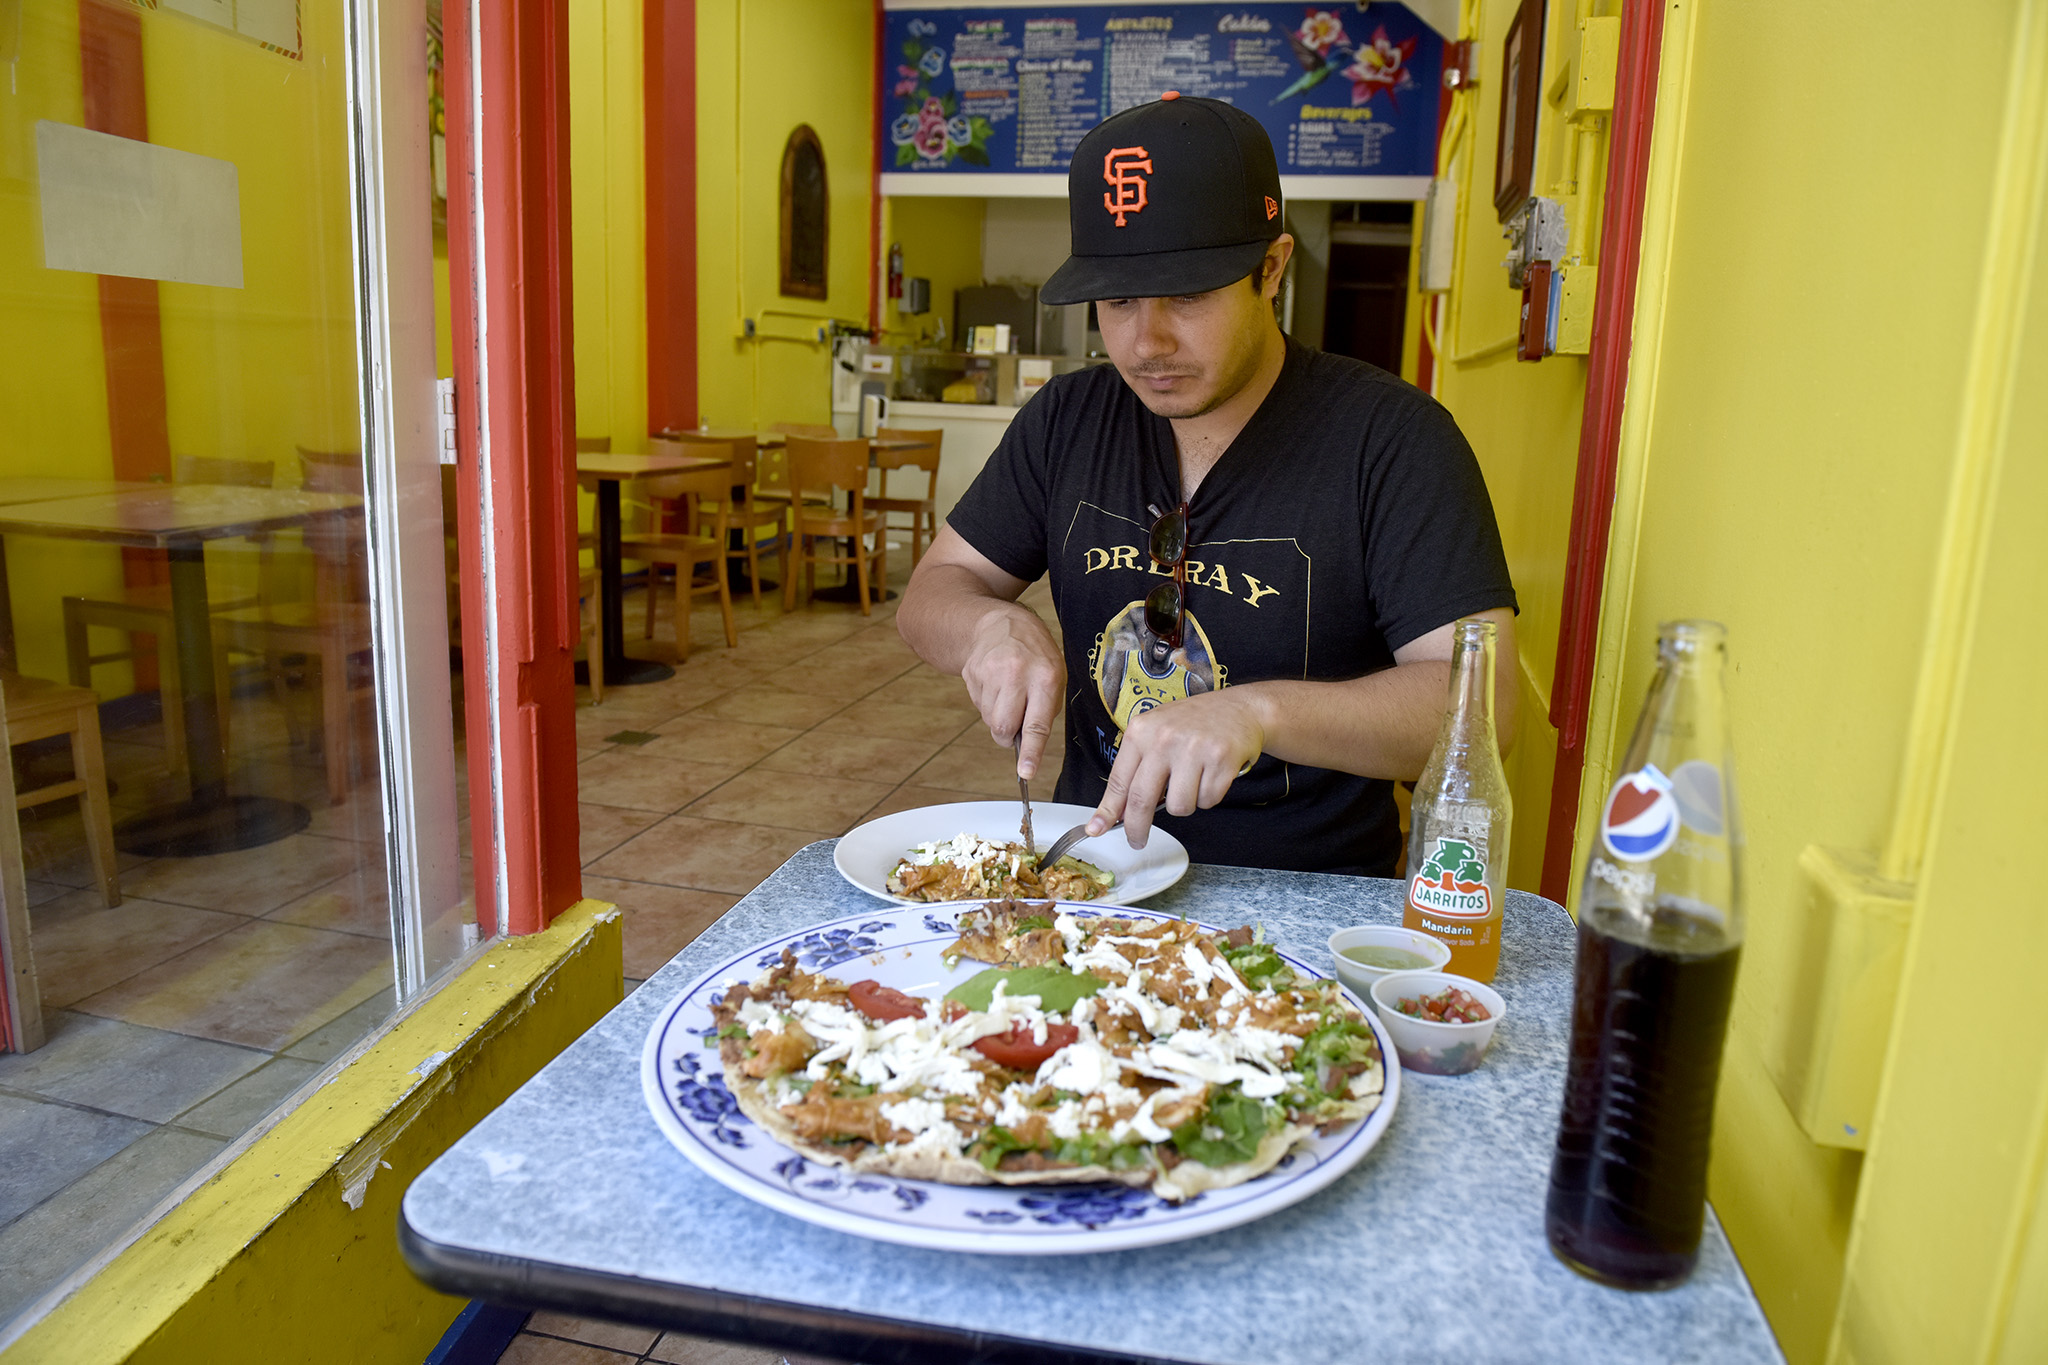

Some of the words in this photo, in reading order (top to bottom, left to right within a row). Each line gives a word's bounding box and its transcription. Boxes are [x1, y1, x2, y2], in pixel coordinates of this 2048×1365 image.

[1103, 146, 1153, 227] SF
[1132, 685, 1176, 702] CIT
[1415, 886, 1485, 910] JARRITOS
[1421, 918, 1473, 935] Mandarin
